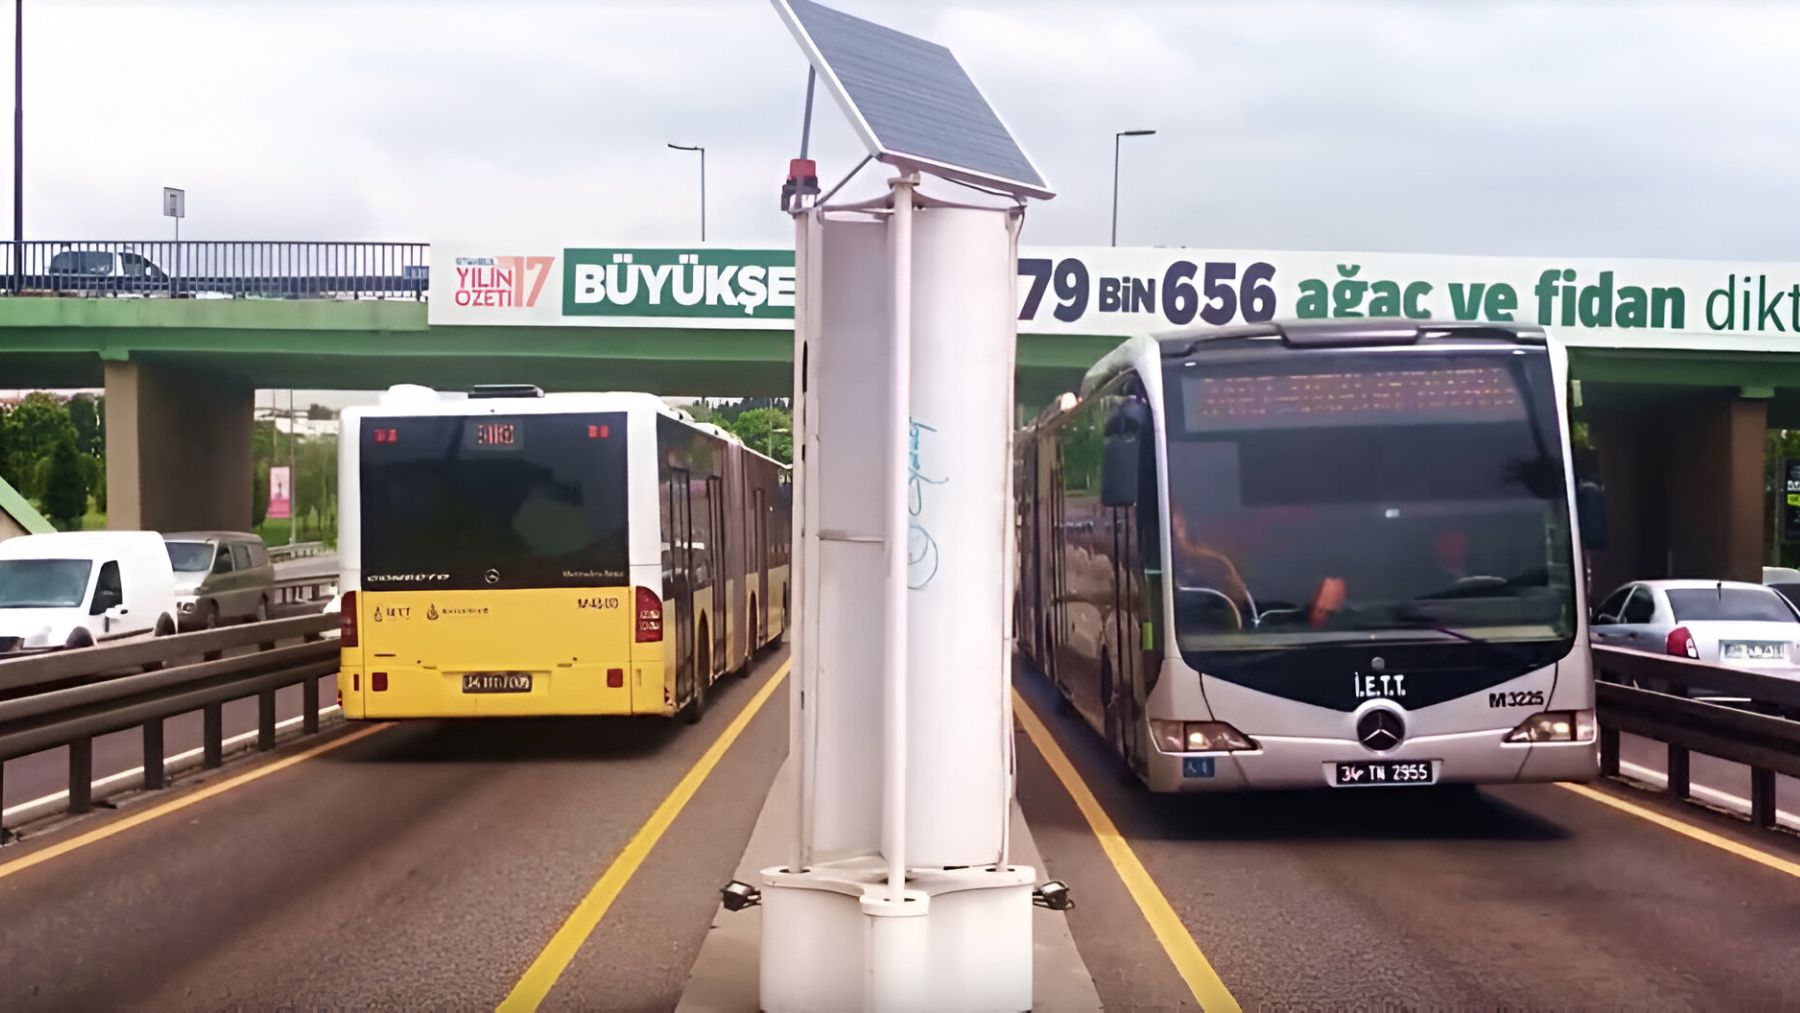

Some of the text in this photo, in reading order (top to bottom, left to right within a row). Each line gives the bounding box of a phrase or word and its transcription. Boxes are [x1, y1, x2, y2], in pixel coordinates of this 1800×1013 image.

[1017, 258, 1089, 322] 79
[1162, 260, 1276, 325] 656
[1448, 281, 1518, 322] ve
[1535, 269, 1685, 329] fidan
